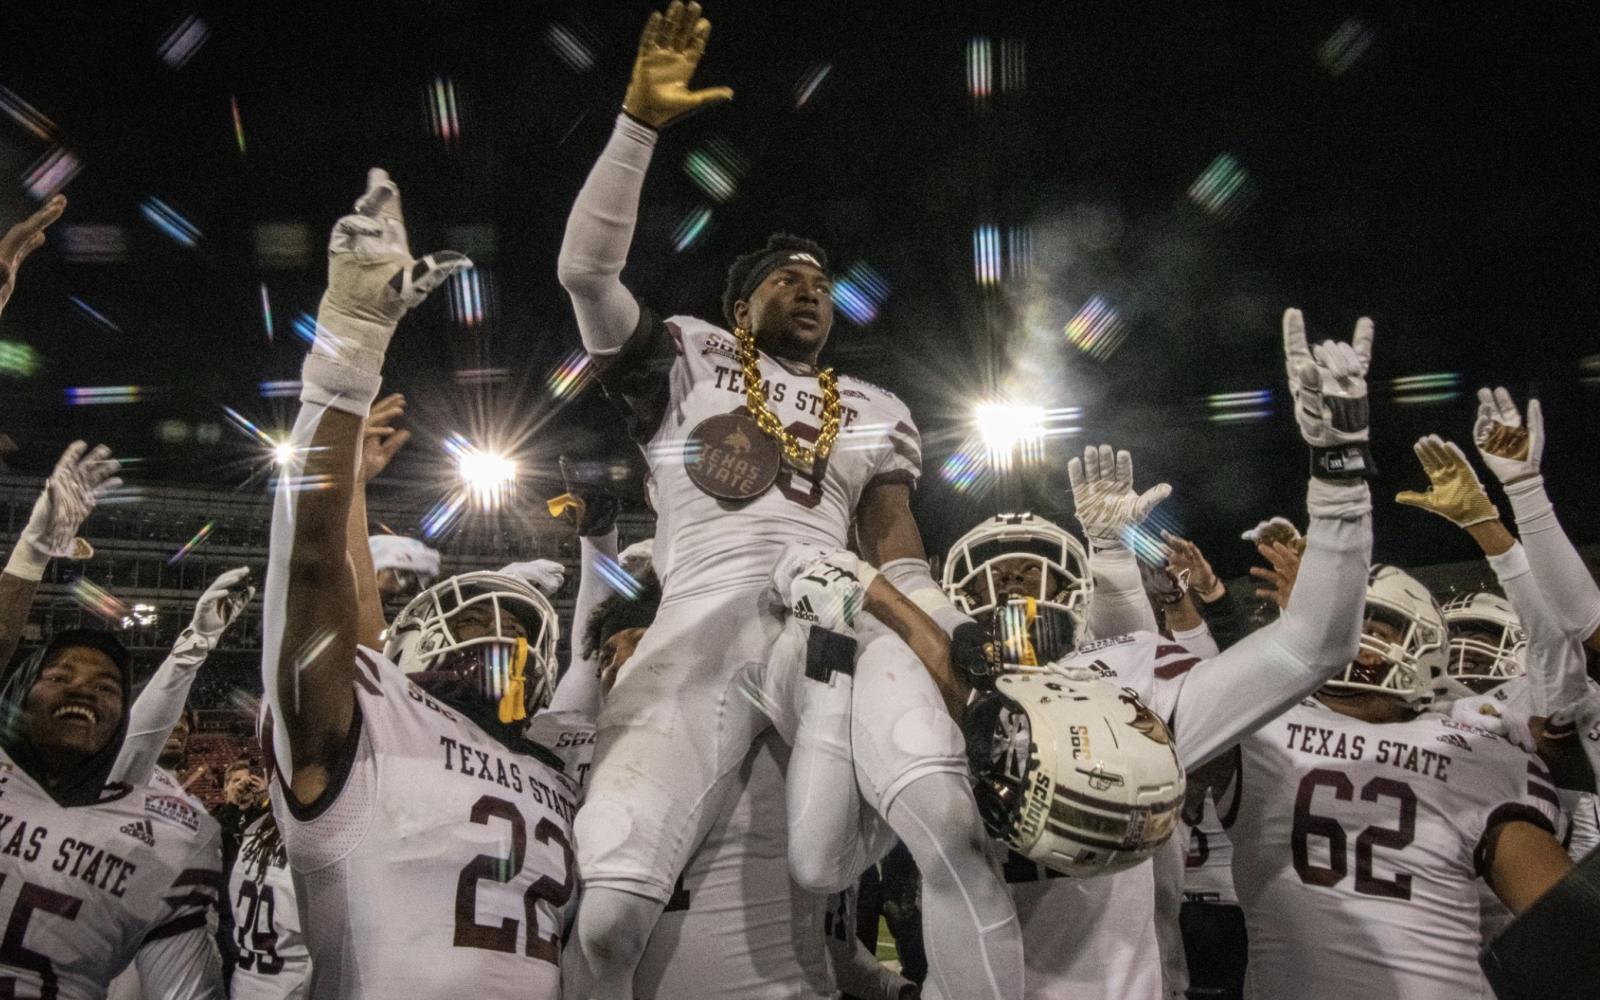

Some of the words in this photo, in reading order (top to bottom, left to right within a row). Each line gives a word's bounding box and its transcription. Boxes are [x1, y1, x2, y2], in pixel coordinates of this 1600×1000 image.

[704, 333, 746, 357] SB
[714, 365, 787, 402] TEAS
[691, 461, 754, 494] STATE
[702, 443, 760, 481] TEXAS
[440, 735, 524, 793] TEXAS
[1287, 723, 1365, 760] TEXAS
[1376, 740, 1451, 783] STATE
[119, 825, 156, 848] adidas
[1291, 768, 1417, 901] 62
[52, 837, 136, 898] STATE
[453, 794, 574, 966] 22
[0, 873, 84, 1000] 5
